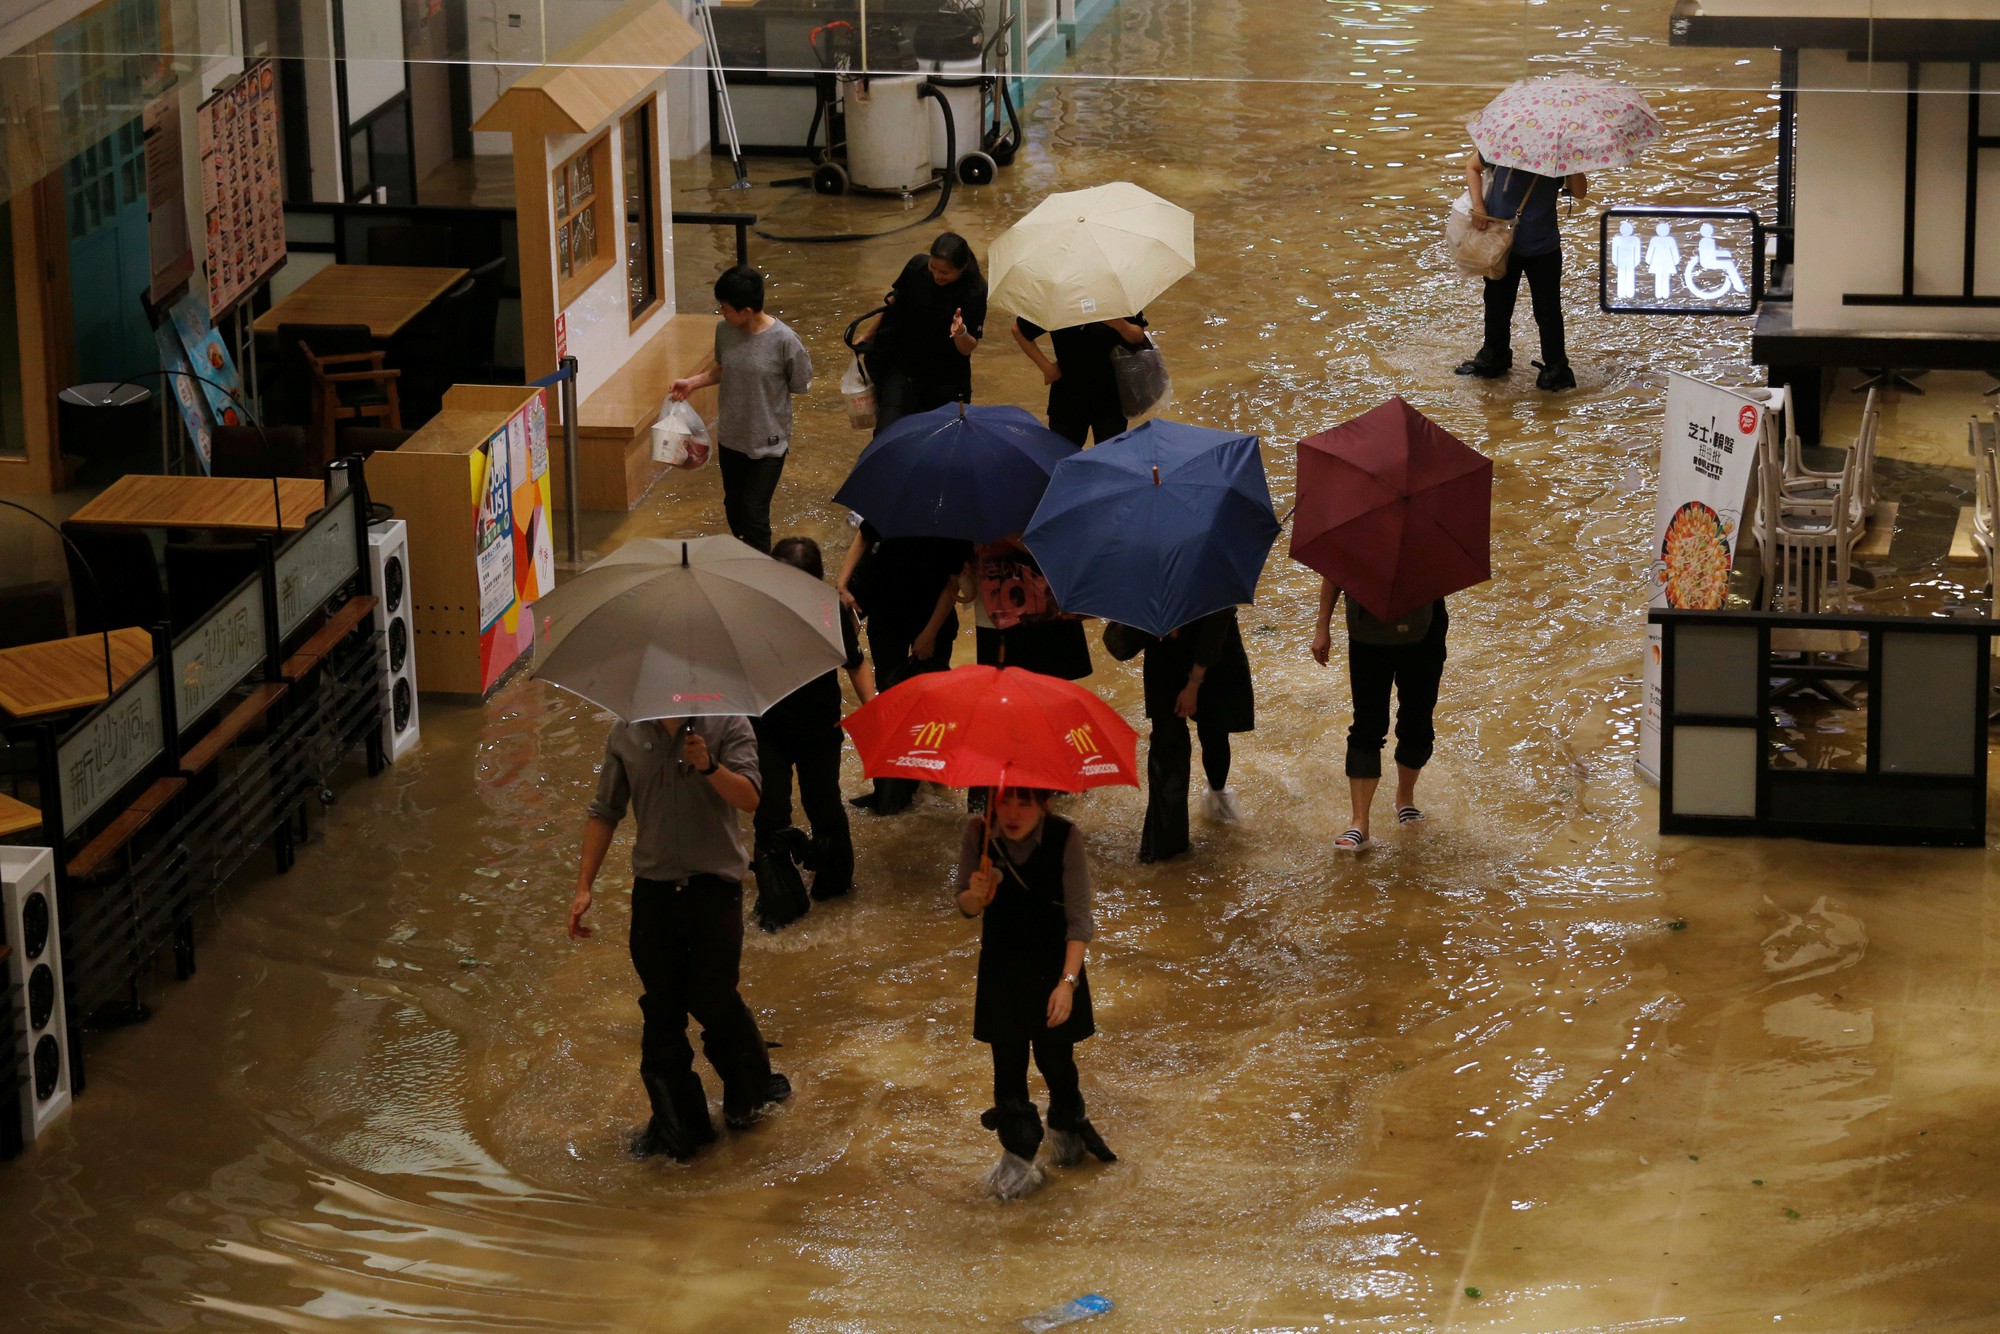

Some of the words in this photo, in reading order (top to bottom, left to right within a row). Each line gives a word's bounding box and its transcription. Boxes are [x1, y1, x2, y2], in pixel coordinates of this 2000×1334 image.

[490, 461, 507, 493] JOIN
[1693, 456, 1723, 475] ROULETTE
[490, 481, 508, 519] US!
